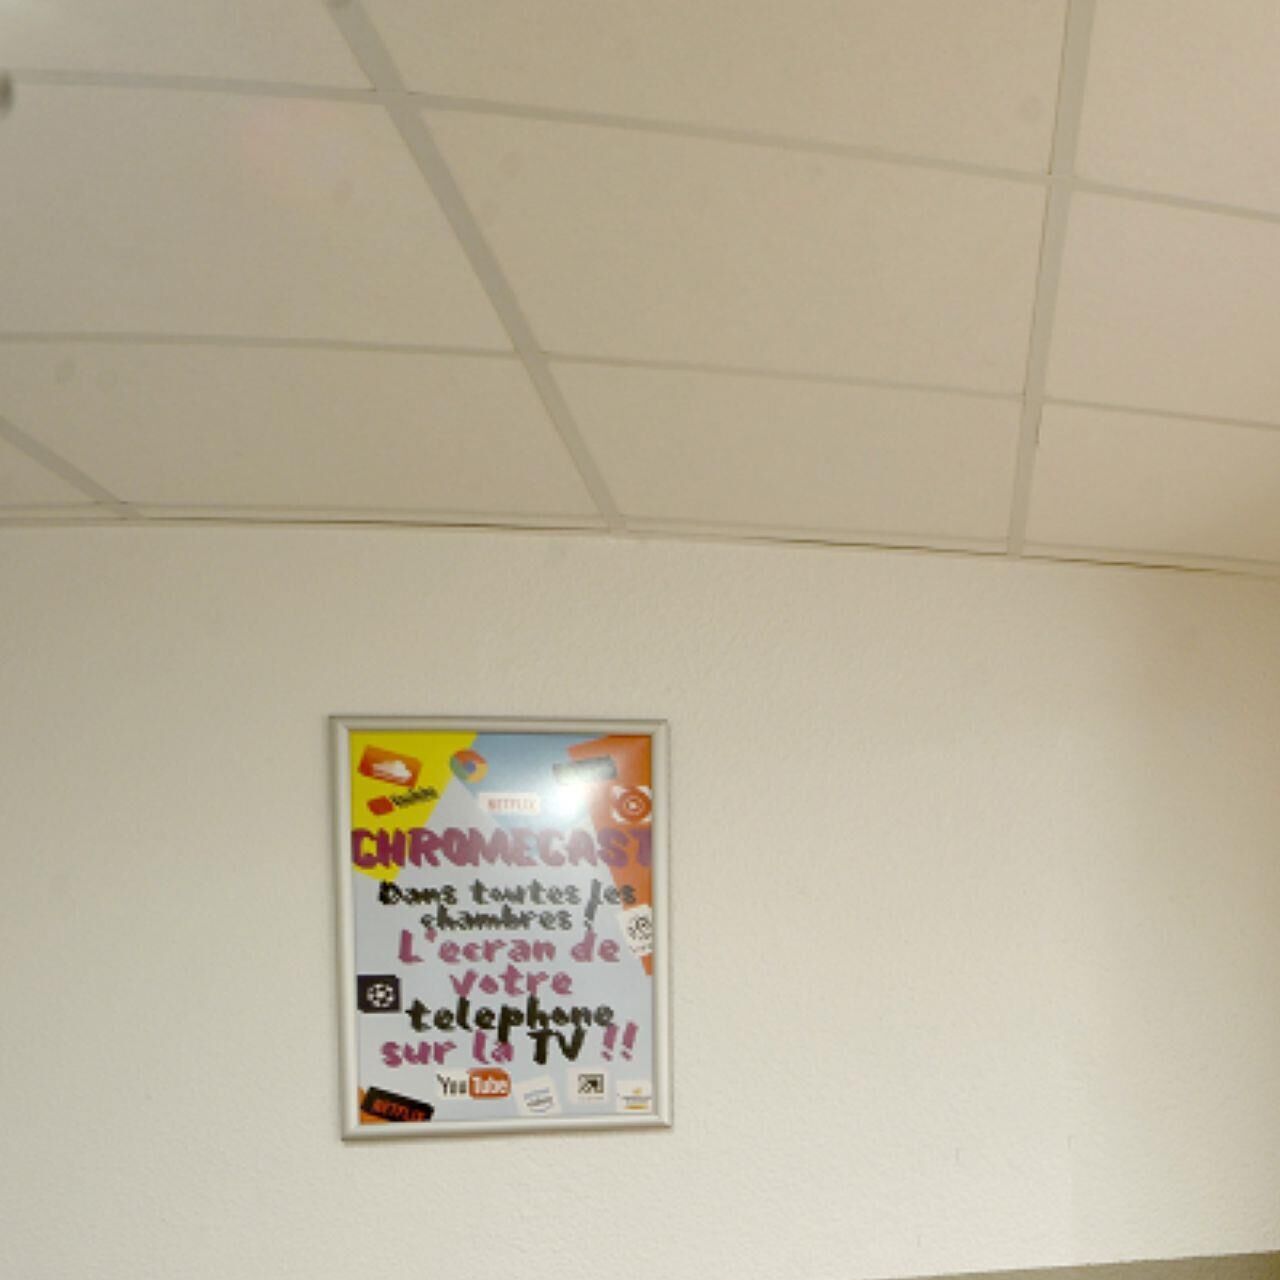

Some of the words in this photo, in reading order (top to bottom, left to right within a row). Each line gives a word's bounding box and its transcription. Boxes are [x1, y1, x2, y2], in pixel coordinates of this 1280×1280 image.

[379, 879, 457, 905] Dans
[469, 878, 580, 905] toutes
[420, 904, 573, 931] chambres
[570, 928, 620, 963] de
[450, 964, 573, 997] votre
[404, 996, 614, 1044] telephone
[379, 1039, 456, 1068] sur
[471, 1029, 515, 1064] la
[526, 1024, 587, 1065] TV
[436, 1070, 510, 1097] YouTube
